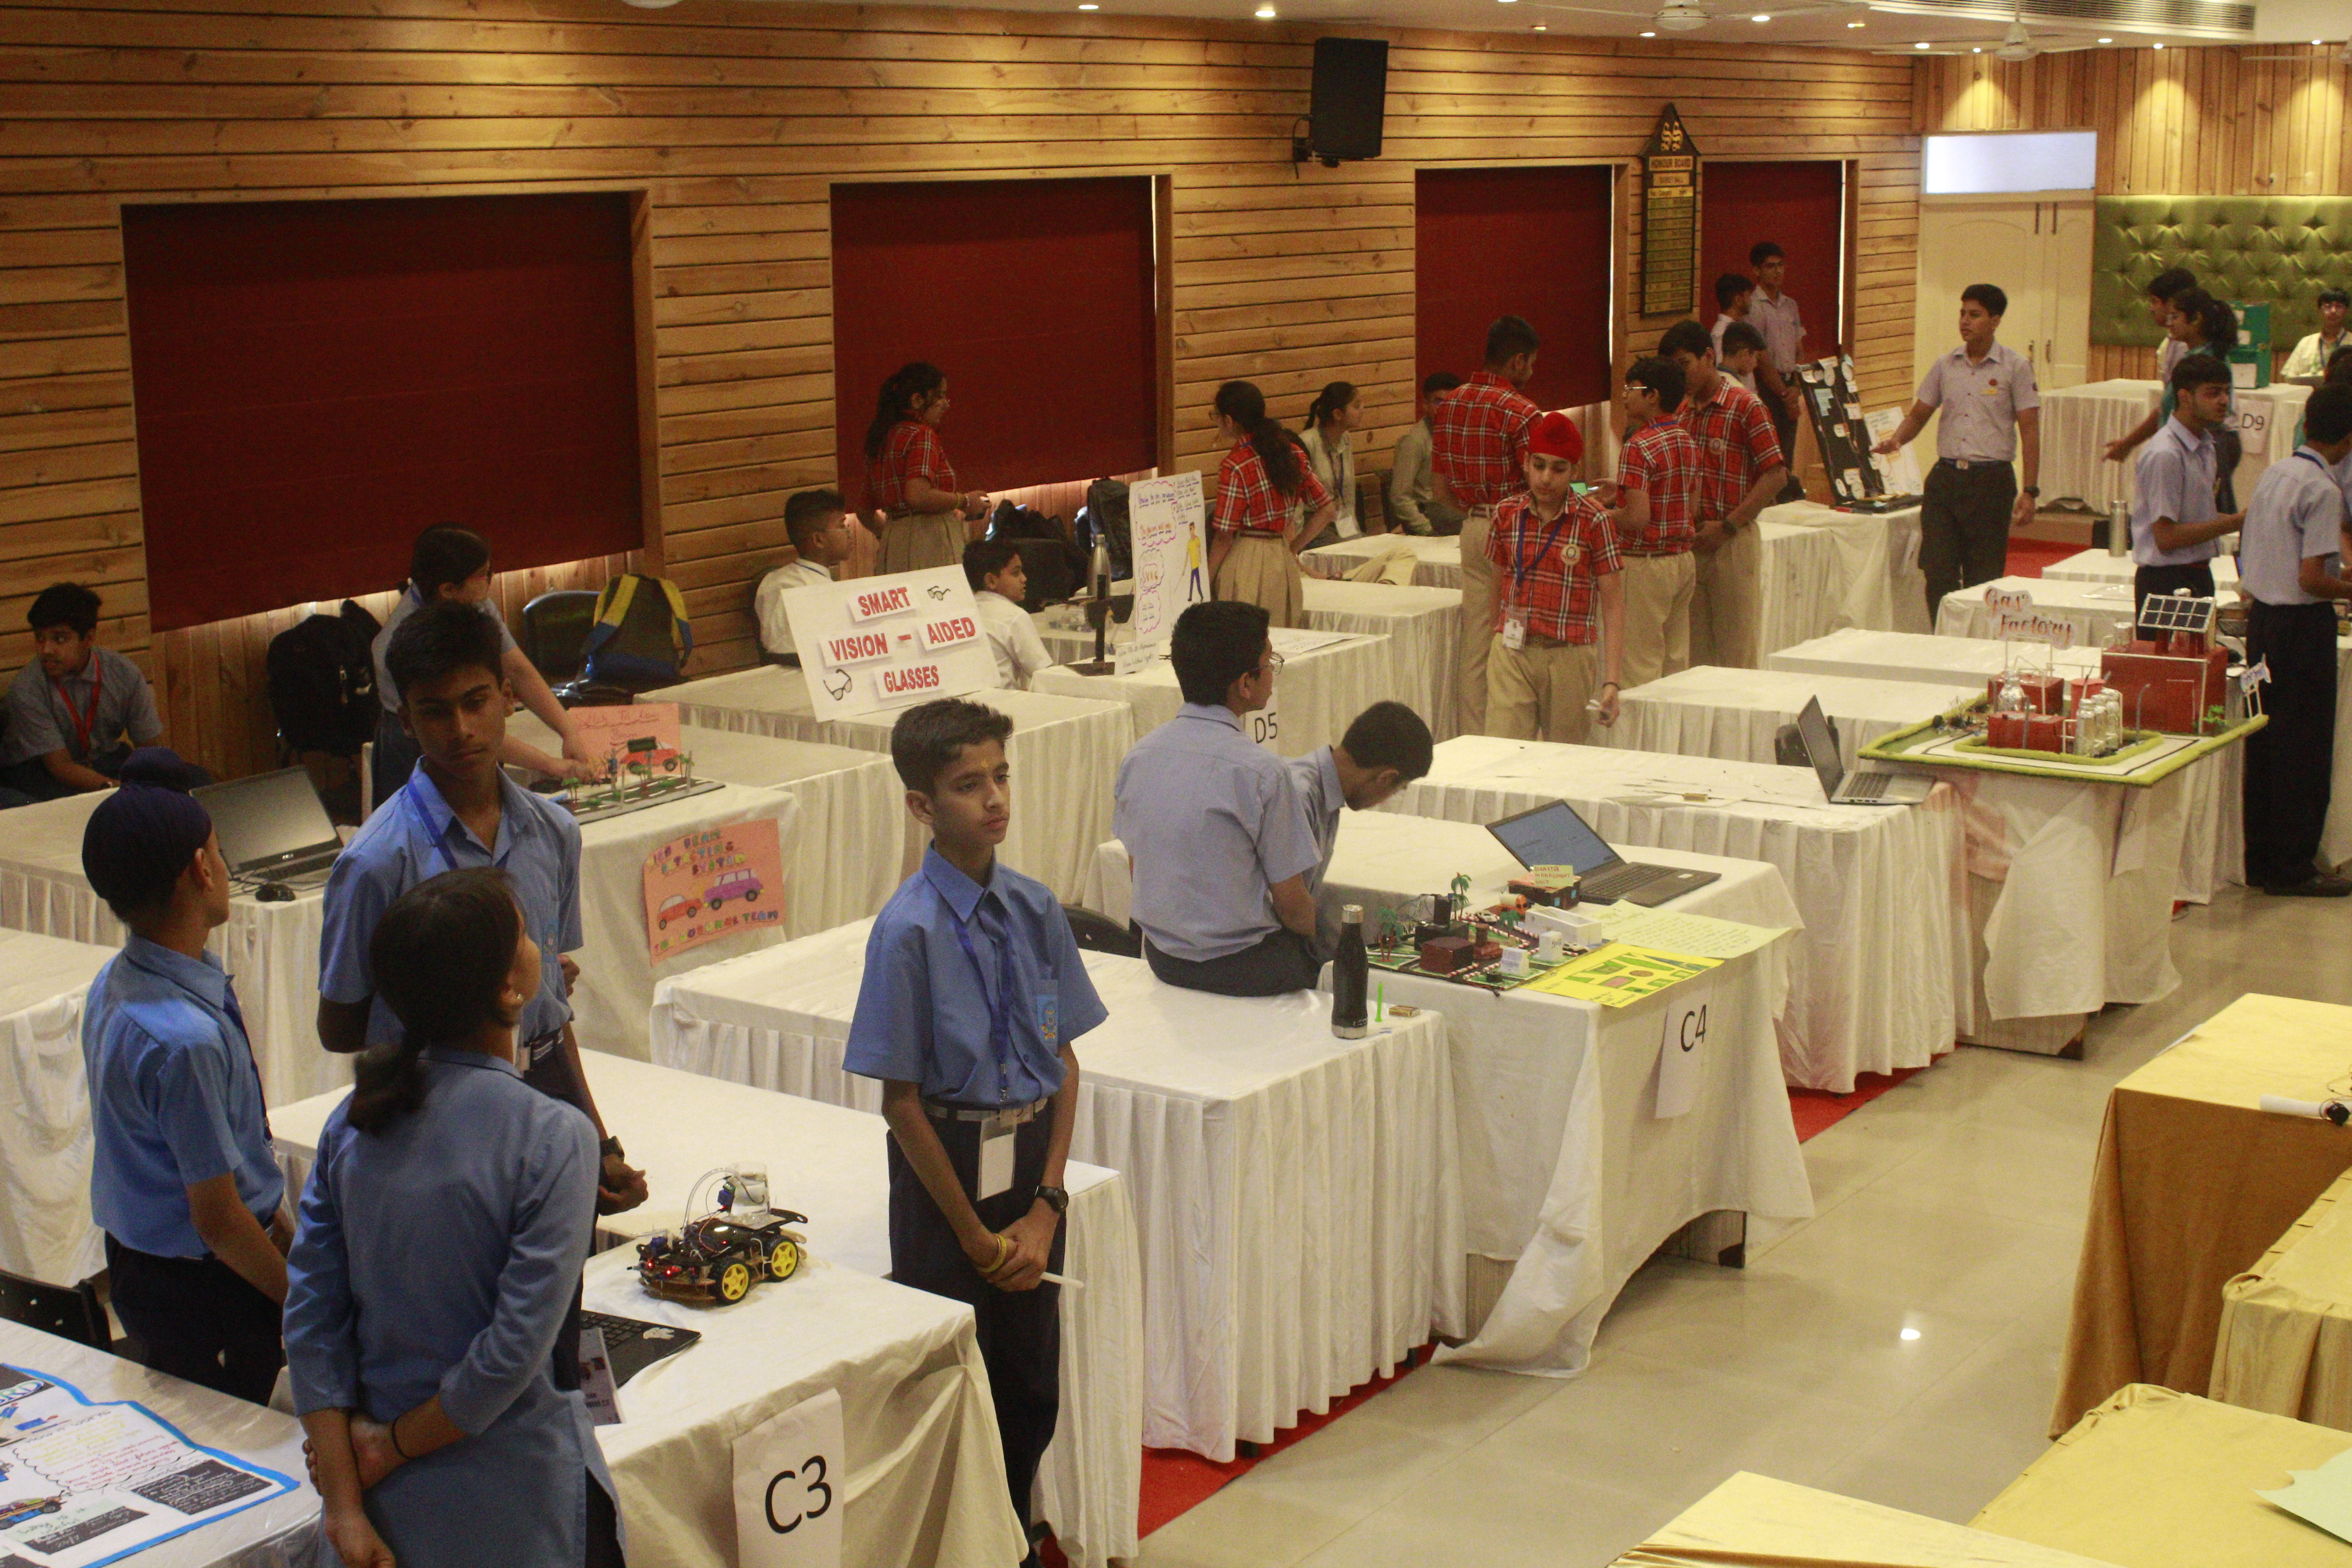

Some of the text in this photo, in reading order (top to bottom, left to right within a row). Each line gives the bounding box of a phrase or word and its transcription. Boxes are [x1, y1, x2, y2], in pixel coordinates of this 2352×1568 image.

[2242, 413, 2264, 431] D9
[858, 587, 911, 617] SMART
[1986, 589, 2028, 617] Gas
[829, 632, 888, 661] VISION
[926, 617, 975, 644] AIDED
[2000, 614, 2071, 646] Factory
[883, 665, 940, 692] GLASSES
[1255, 713, 1277, 743] D5
[684, 829, 721, 848] BEAM
[742, 910, 778, 922] TEAM
[1681, 1004, 1706, 1052] C4
[765, 1454, 832, 1534] C3
